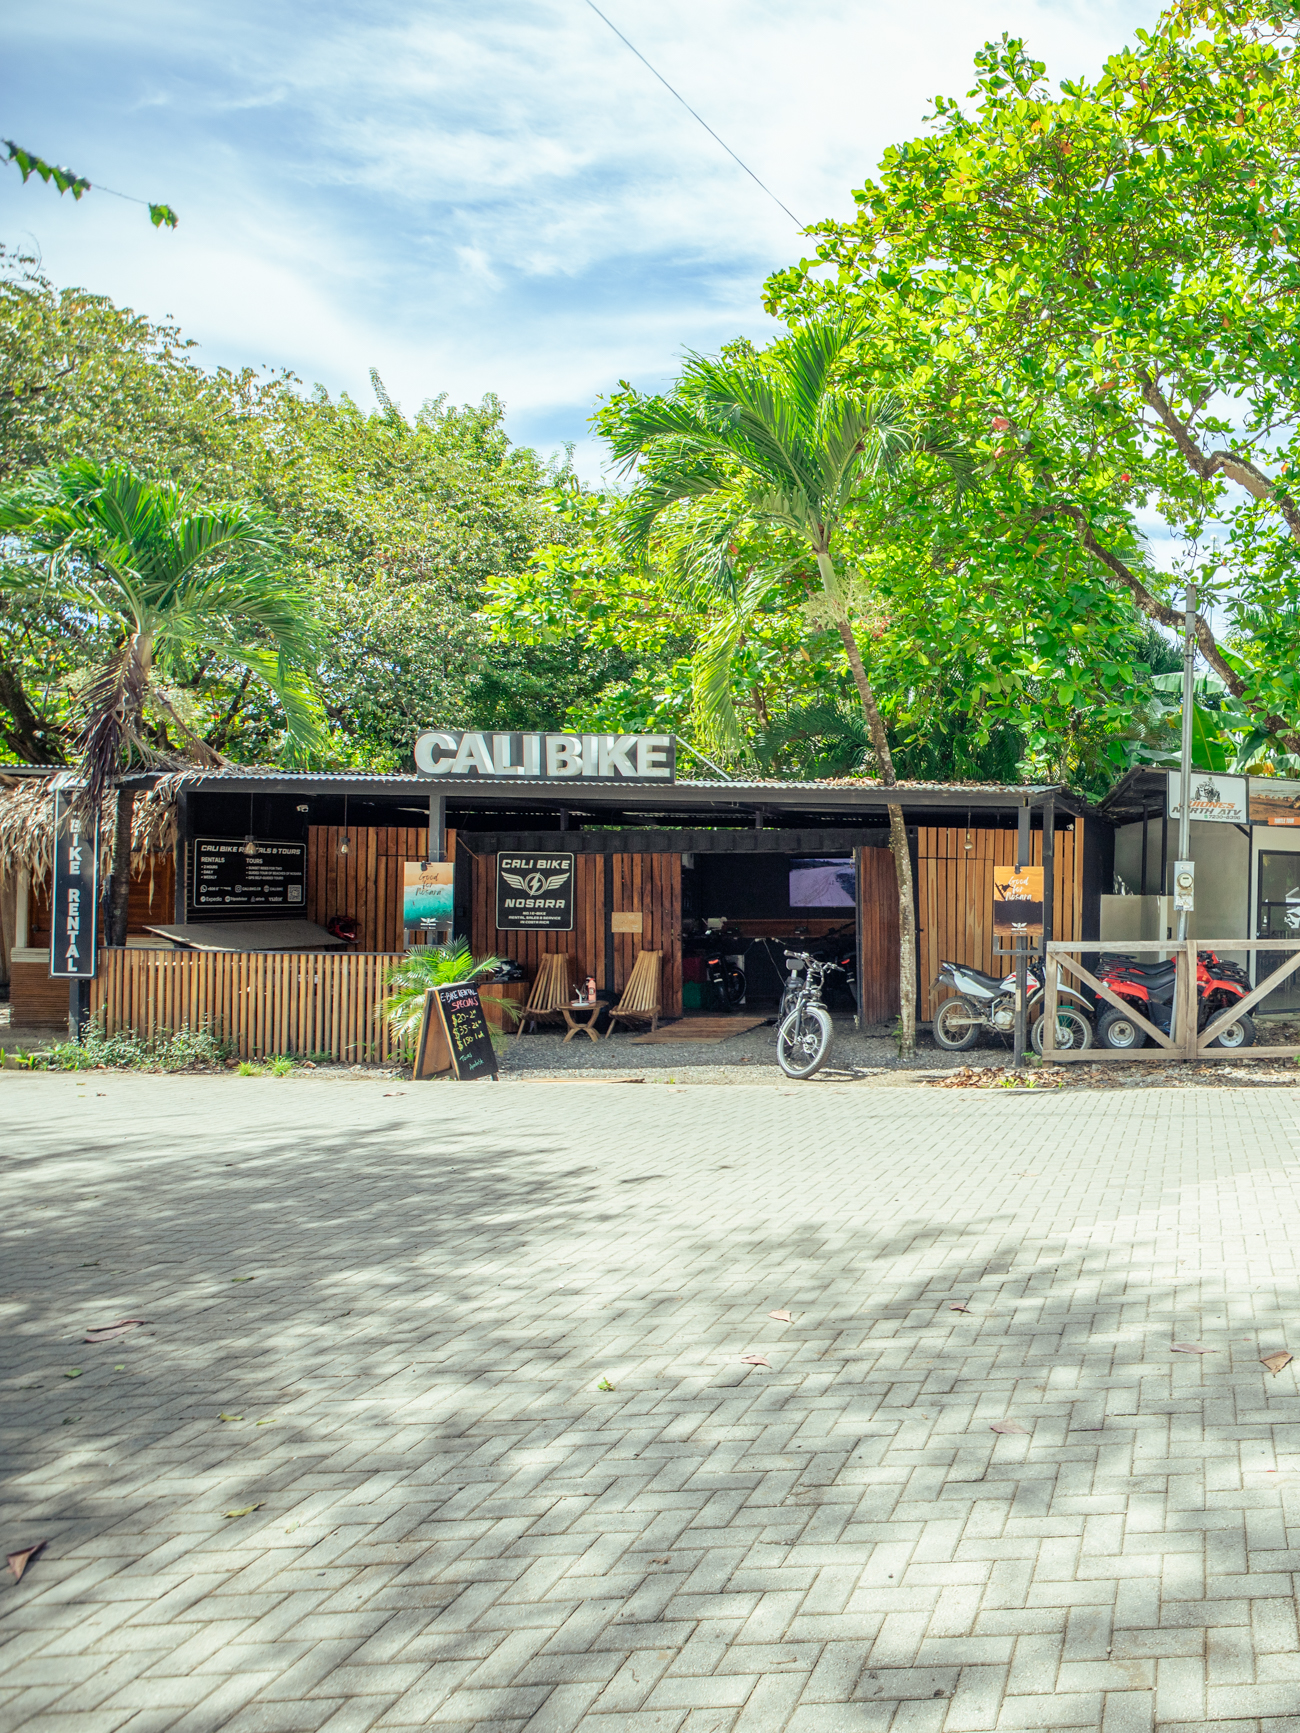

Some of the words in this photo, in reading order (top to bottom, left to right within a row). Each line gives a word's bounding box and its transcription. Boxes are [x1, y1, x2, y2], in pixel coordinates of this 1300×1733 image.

[414, 733, 540, 775] CALI
[546, 735, 670, 777] BIKE
[1178, 801, 1235, 809] UIONES
[1171, 806, 1214, 815] NRTH
[220, 845, 238, 853] BIKE
[239, 846, 272, 854] RALS
[502, 859, 534, 869] CALI
[536, 860, 570, 869] BIKE
[419, 873, 439, 881] Good
[1008, 876, 1029, 886] Good
[416, 887, 442, 896] Nosara
[1012, 884, 1024, 894] for
[1005, 892, 1032, 901] Nosara
[504, 899, 566, 909] NOSARA
[65, 888, 81, 972] RENTAL
